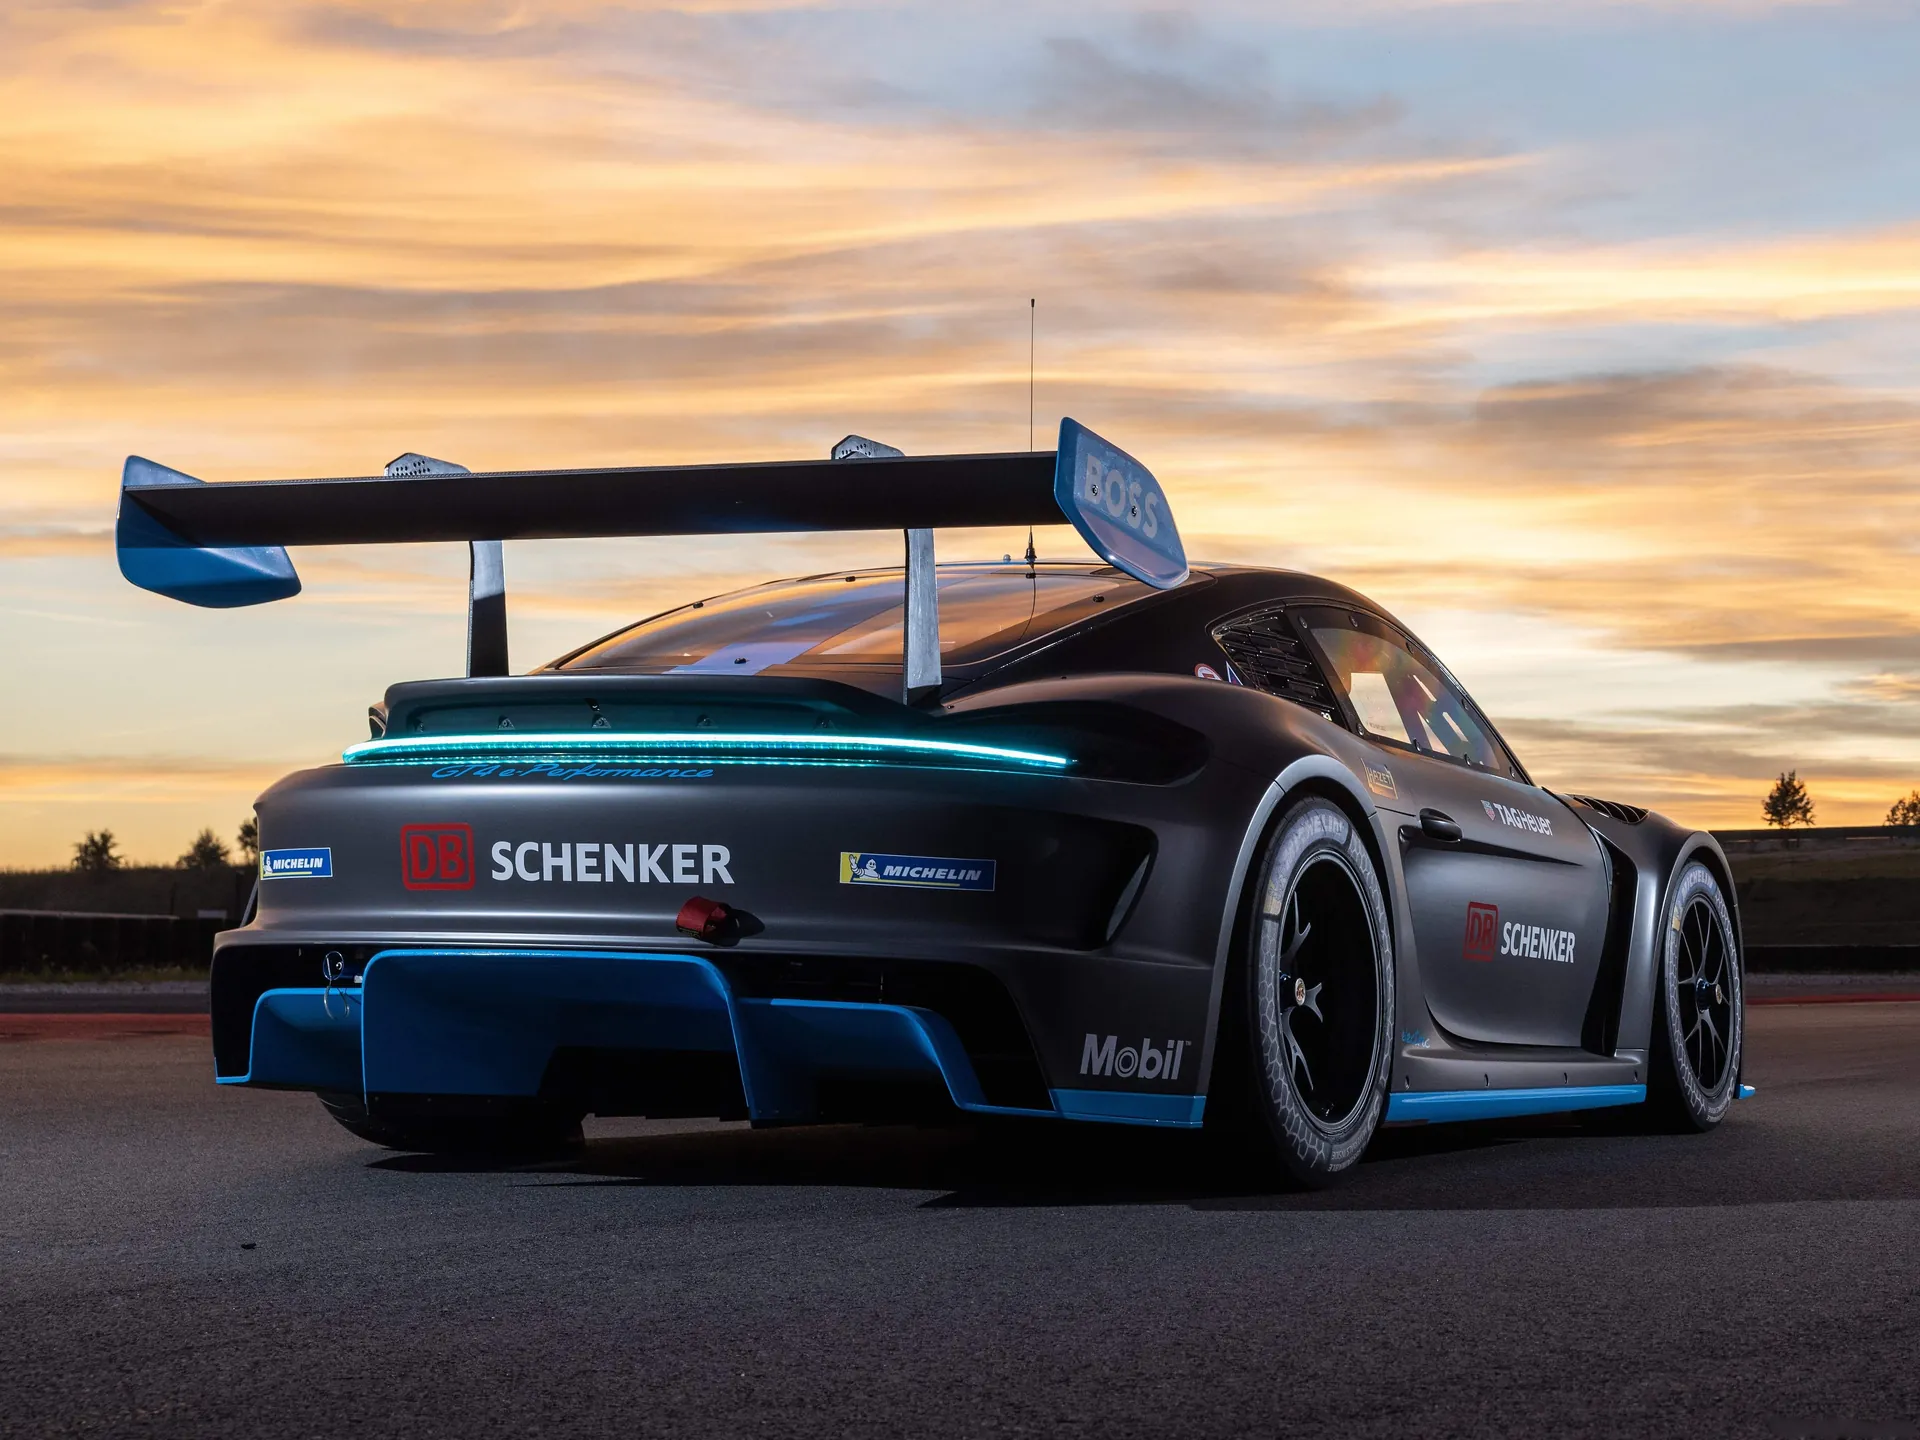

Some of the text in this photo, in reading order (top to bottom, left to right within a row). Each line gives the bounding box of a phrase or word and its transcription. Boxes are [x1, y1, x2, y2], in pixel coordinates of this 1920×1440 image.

[1085, 453, 1159, 539] BOSS
[432, 763, 713, 781] GT4 e-Performance
[273, 857, 323, 870] MICHELIN
[410, 834, 735, 884] DB SCHENKER
[883, 865, 981, 881] MICHELIN
[1469, 912, 1576, 963] DB SCHENKER
[1080, 1033, 1184, 1080] Mobil
